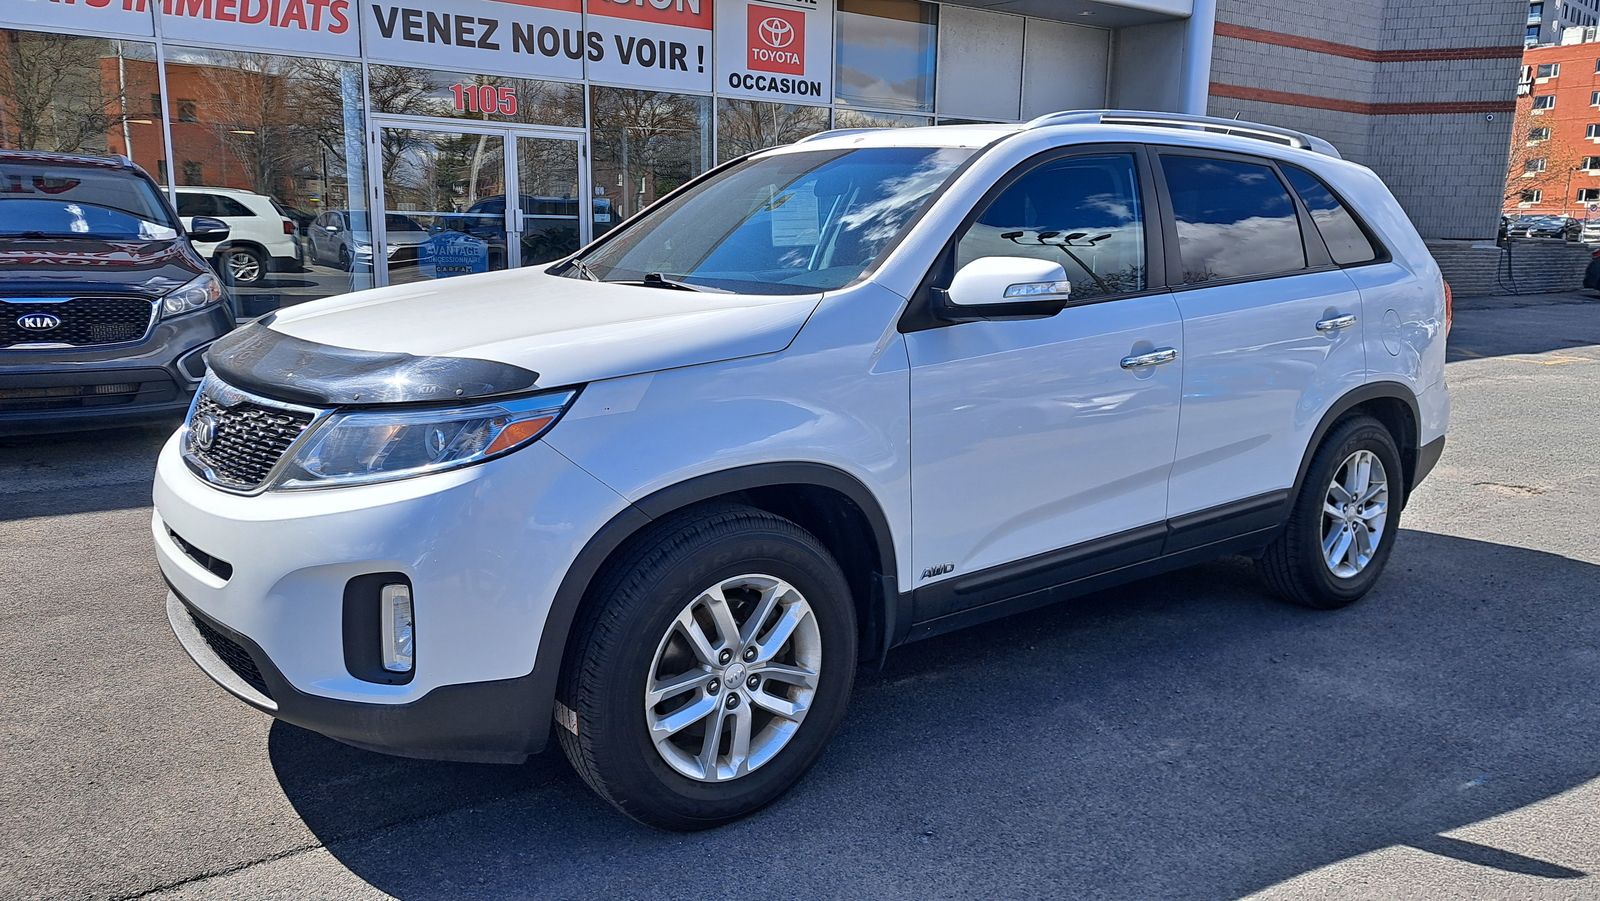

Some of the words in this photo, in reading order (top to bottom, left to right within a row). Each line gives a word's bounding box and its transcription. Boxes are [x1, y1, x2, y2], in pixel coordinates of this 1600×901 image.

[372, 4, 500, 50] VENEZ
[512, 22, 605, 62] NOUS
[614, 34, 689, 71] VOIR
[697, 45, 704, 73] !
[752, 48, 800, 65] TOYOTA
[1519, 64, 1532, 84] L
[729, 72, 822, 97] OCCASION
[449, 84, 518, 115] 1105
[426, 245, 481, 256] AVANTAGE
[436, 265, 473, 273] CARFAX
[24, 317, 54, 328] KIA
[418, 385, 437, 394] KIA
[919, 563, 955, 580] AWD
